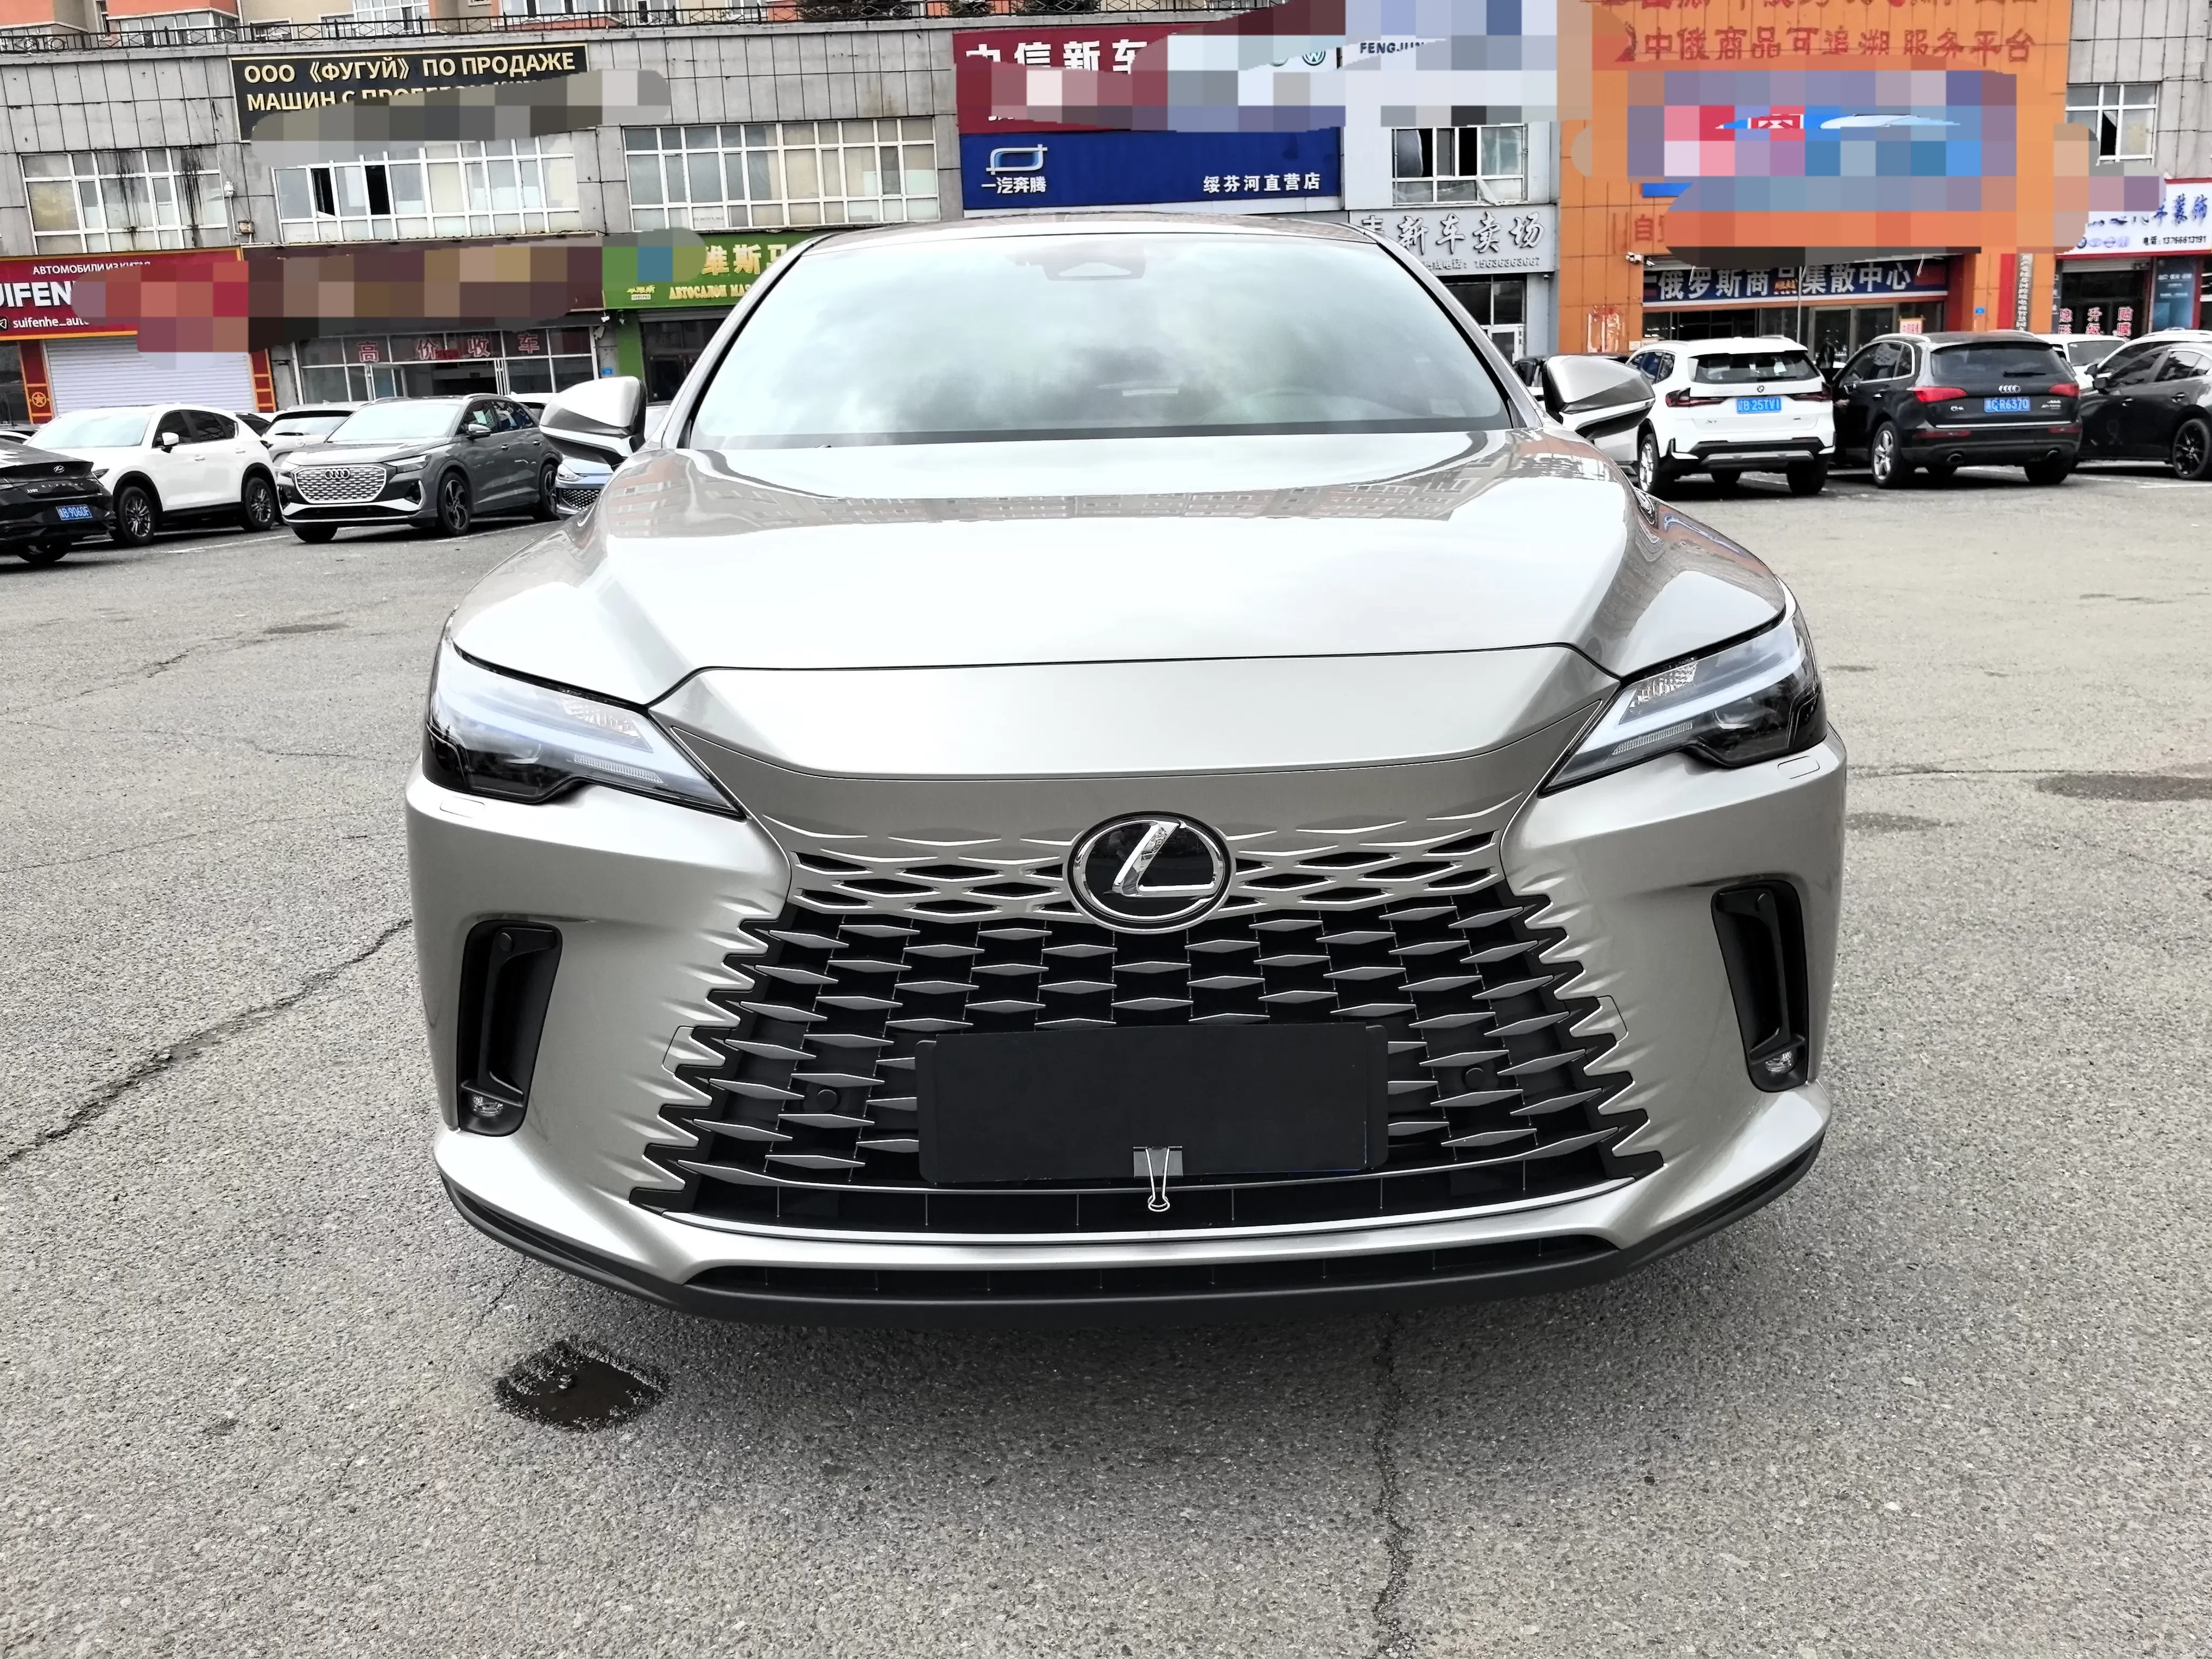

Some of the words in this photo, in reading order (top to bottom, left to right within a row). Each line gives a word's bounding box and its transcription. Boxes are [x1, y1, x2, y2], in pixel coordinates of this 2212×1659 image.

[245, 64, 295, 83] ООО
[423, 58, 455, 77] ПО
[462, 52, 575, 77] ПРОДАЖЕ
[247, 91, 335, 111] МАШИН
[981, 176, 1047, 194] 一汽奔腾
[1203, 172, 1320, 193] 绥芬河直营店
[33, 264, 104, 275] АВТОМОБИЛИ
[0, 280, 76, 308] IFEN
[13, 316, 90, 329] suifenhe_aut
[358, 333, 539, 363] 高价收车
